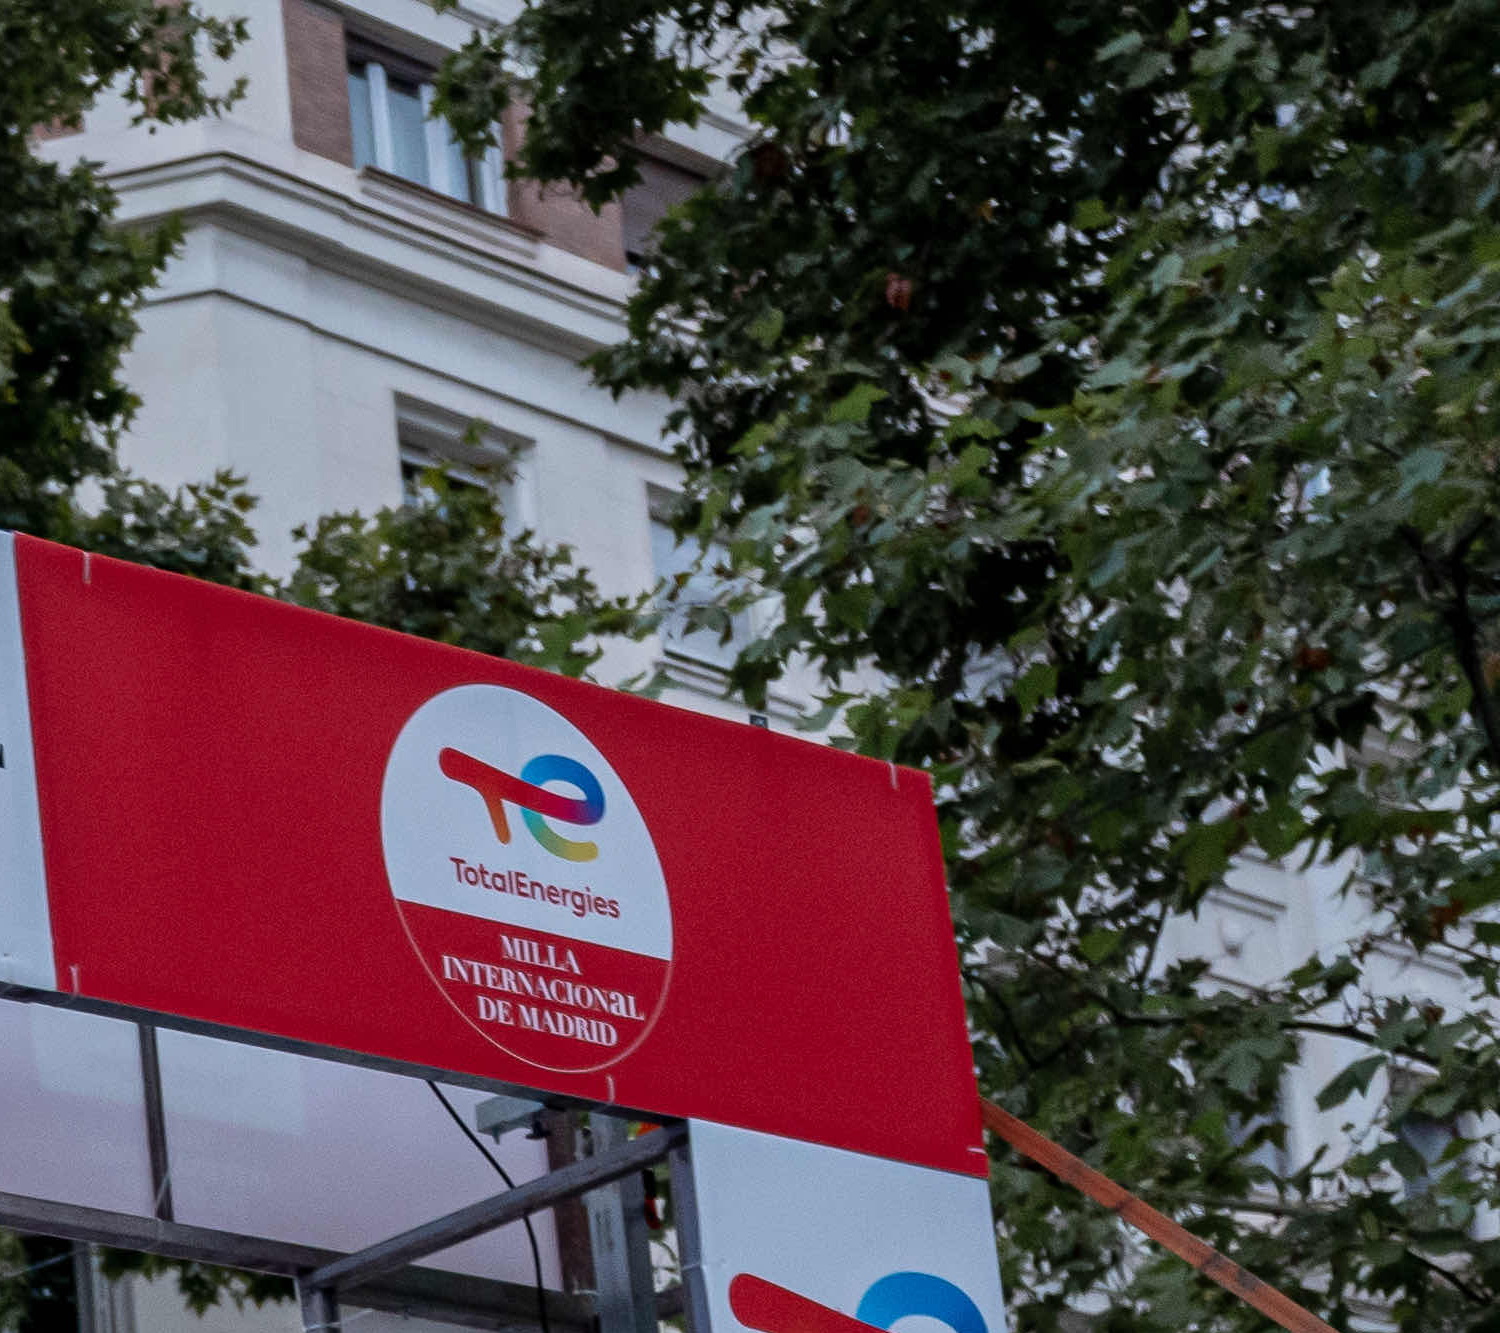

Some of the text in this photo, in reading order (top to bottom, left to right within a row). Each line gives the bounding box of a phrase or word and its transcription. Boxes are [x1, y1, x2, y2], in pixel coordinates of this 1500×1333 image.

[449, 856, 620, 919] TotalEnergies
[500, 935, 582, 975] MILLA
[477, 995, 618, 1047] DE MADRID
